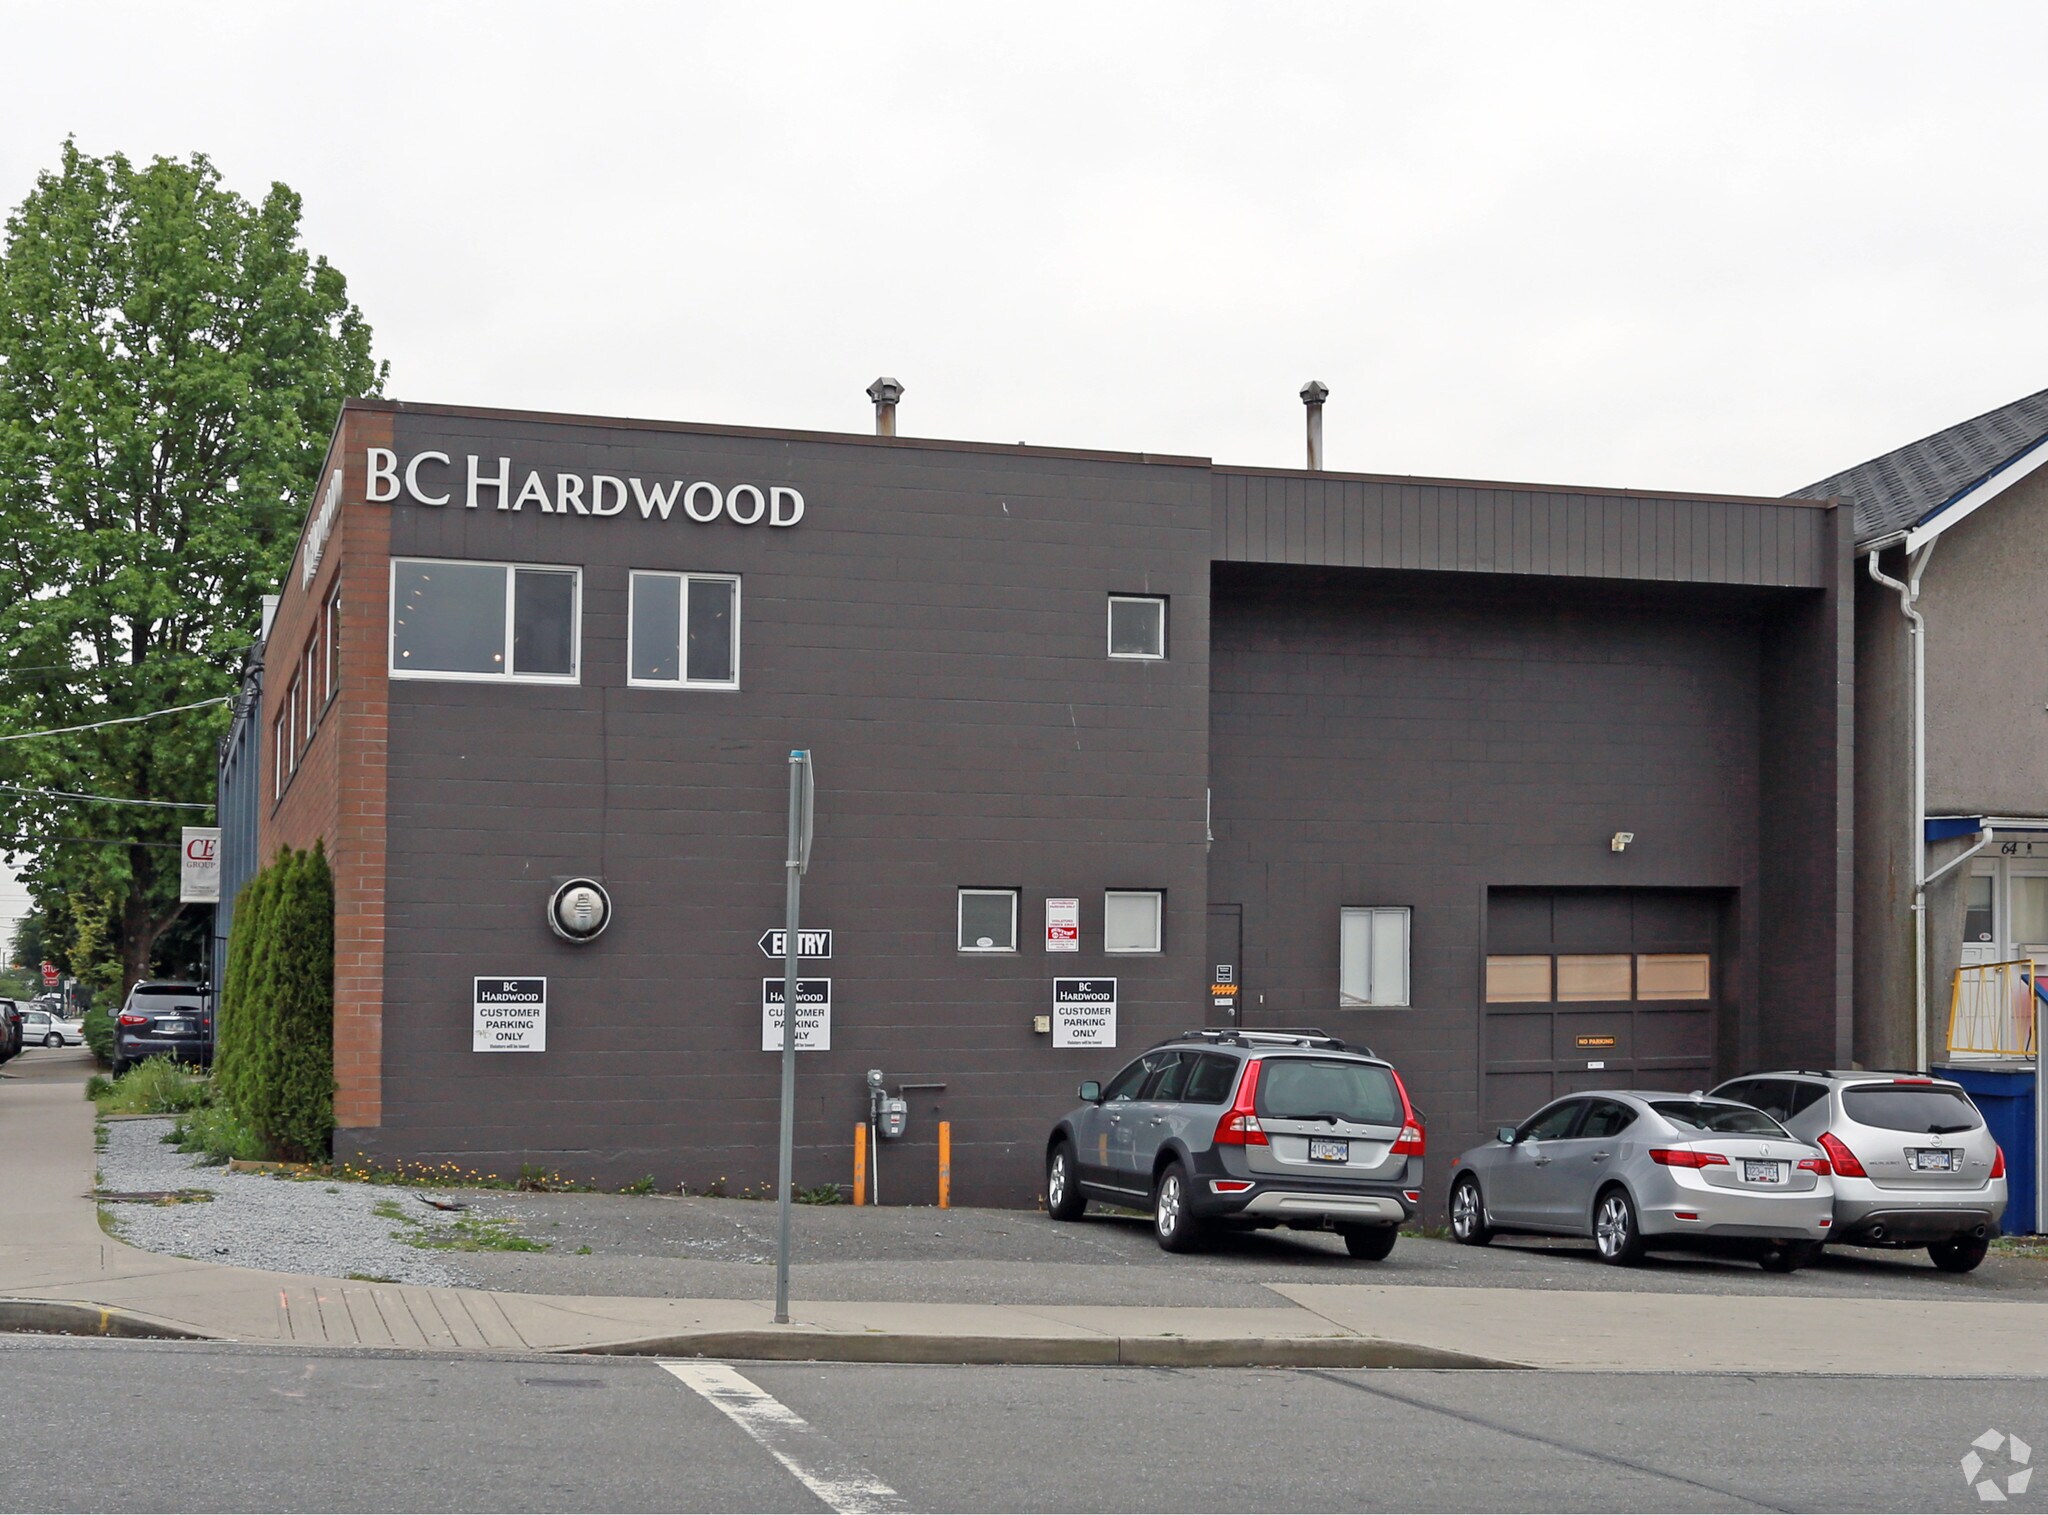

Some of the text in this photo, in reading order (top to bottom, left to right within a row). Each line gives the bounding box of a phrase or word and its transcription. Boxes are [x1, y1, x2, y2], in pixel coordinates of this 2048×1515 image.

[365, 447, 805, 527] BC HARDWOOD
[186, 839, 216, 860] CE
[503, 982, 518, 991] BC
[1079, 982, 1091, 991] BC
[482, 992, 539, 1001] HARDWOOD
[1060, 992, 1110, 1000] HARDWOOD
